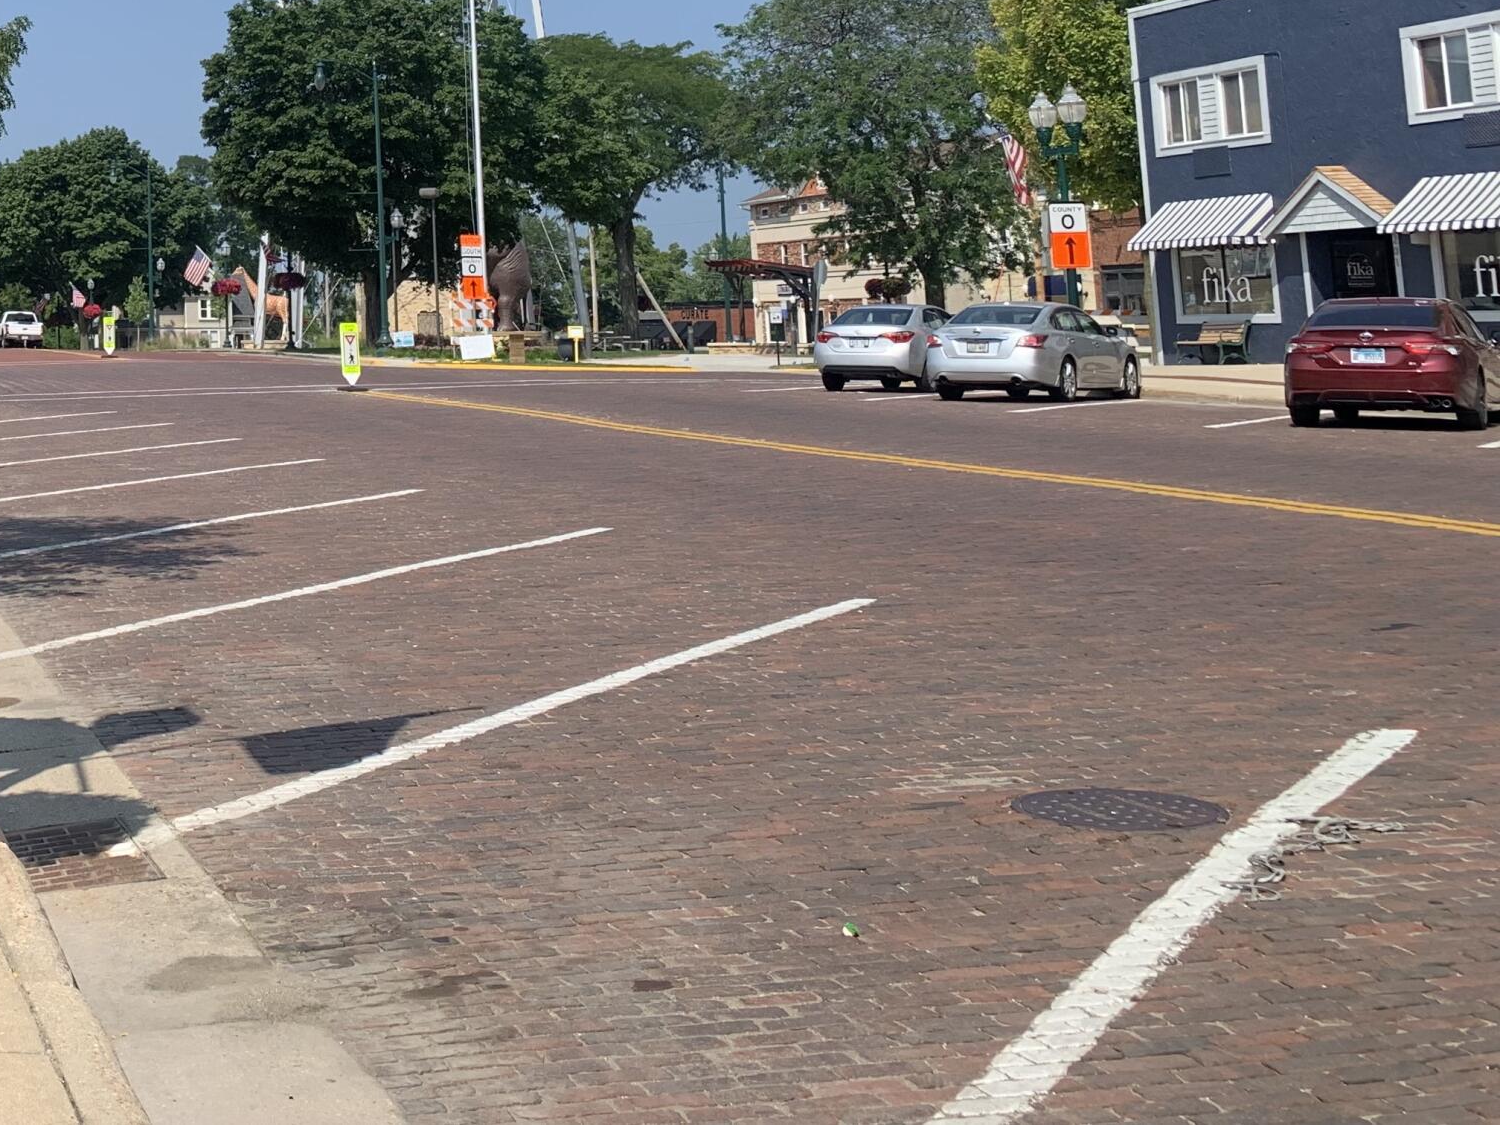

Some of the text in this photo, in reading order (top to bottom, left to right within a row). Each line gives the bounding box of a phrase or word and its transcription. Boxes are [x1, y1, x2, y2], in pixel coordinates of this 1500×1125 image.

[1347, 262, 1374, 276] fika
[1201, 267, 1253, 305] fika
[681, 309, 710, 320] CURATE
